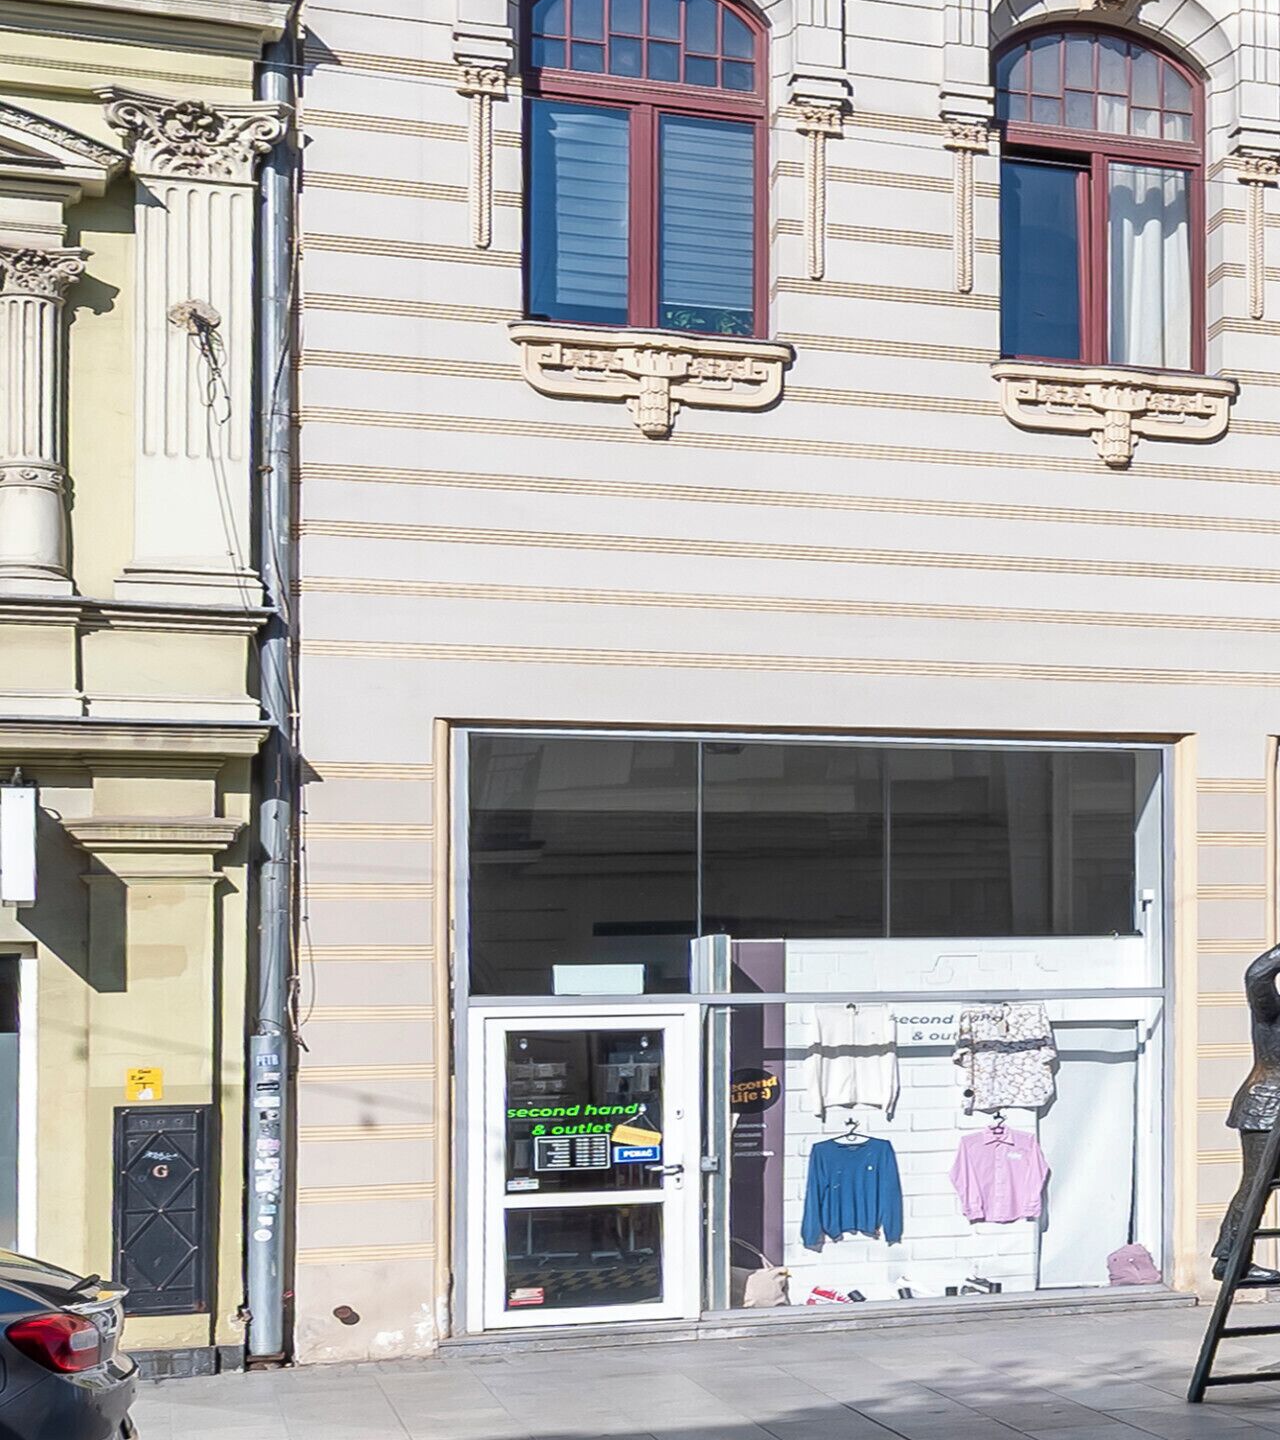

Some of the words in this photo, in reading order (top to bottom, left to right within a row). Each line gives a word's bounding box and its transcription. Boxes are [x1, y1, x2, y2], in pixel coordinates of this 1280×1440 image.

[912, 1032, 923, 1041] &
[731, 1076, 778, 1092] econd
[507, 1104, 580, 1118] second
[585, 1103, 639, 1116] hand
[532, 1124, 546, 1136] &
[551, 1123, 613, 1135] outlet
[152, 1164, 169, 1178] G
